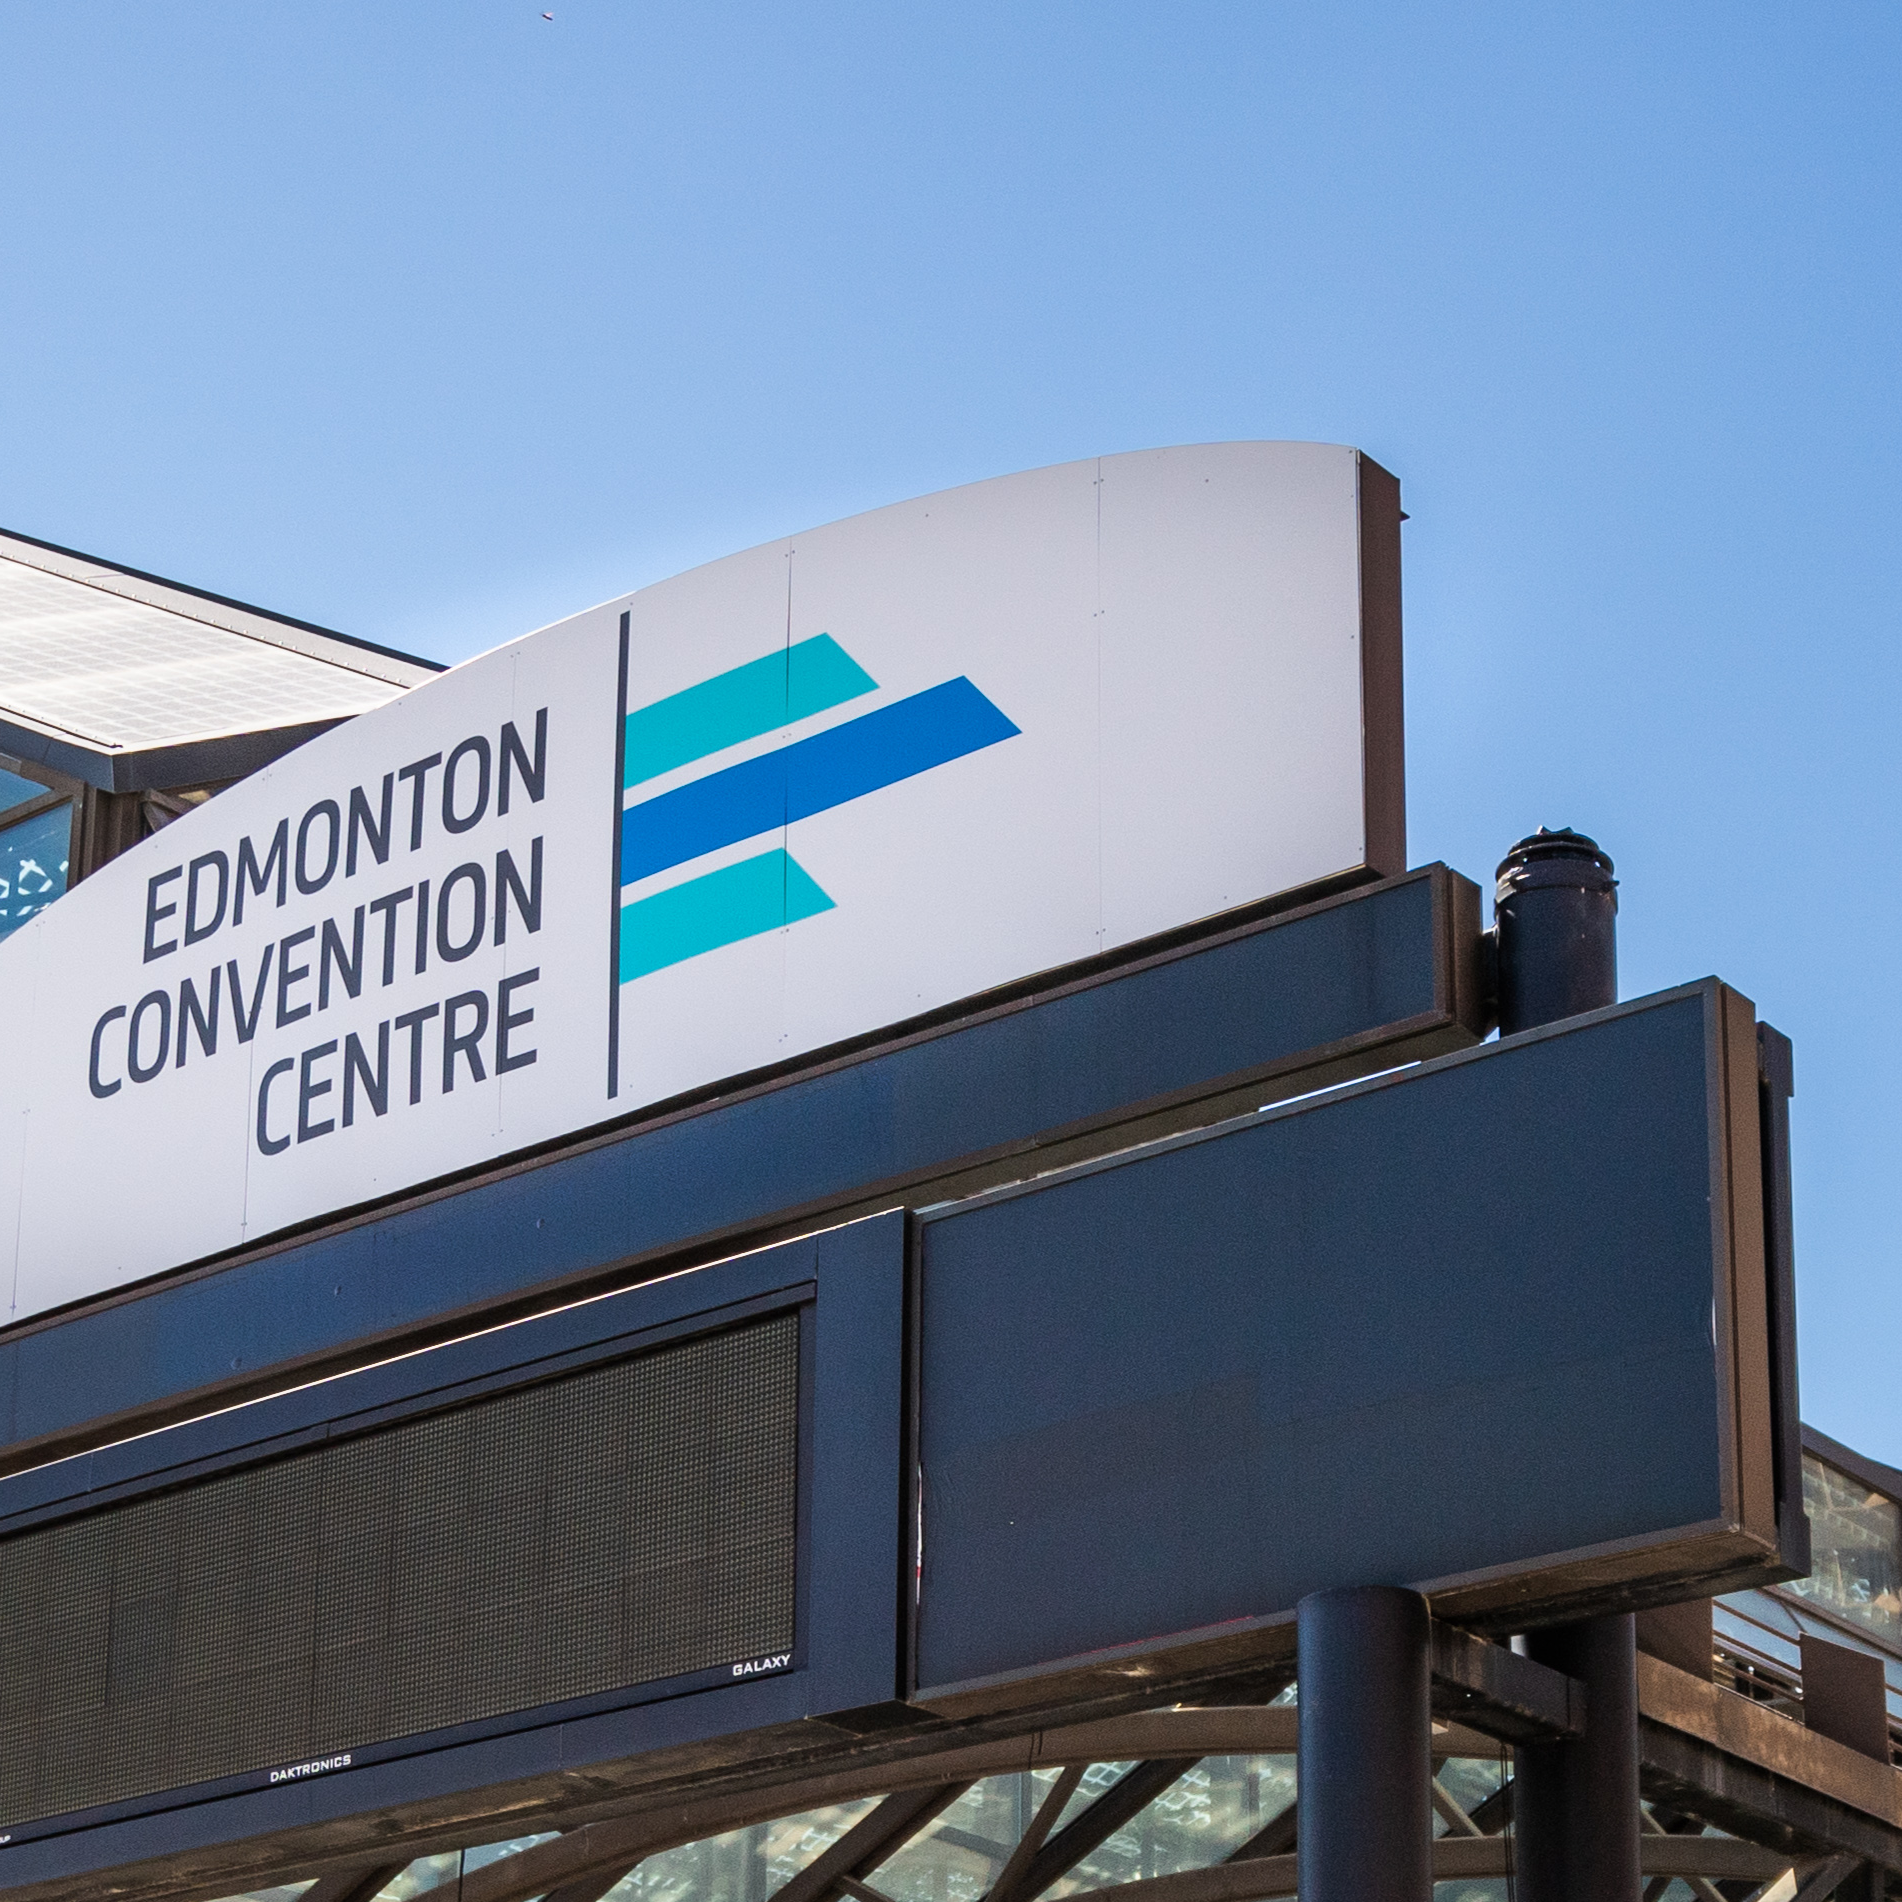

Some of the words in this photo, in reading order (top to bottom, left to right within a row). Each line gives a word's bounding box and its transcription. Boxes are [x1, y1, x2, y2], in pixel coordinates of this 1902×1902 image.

[143, 707, 548, 964] EDMONTON
[89, 836, 543, 1098] CONVENTION
[257, 967, 539, 1155] CENTRE
[732, 1653, 791, 1677] GALAXY
[270, 1754, 352, 1783] DAKTRONICS
